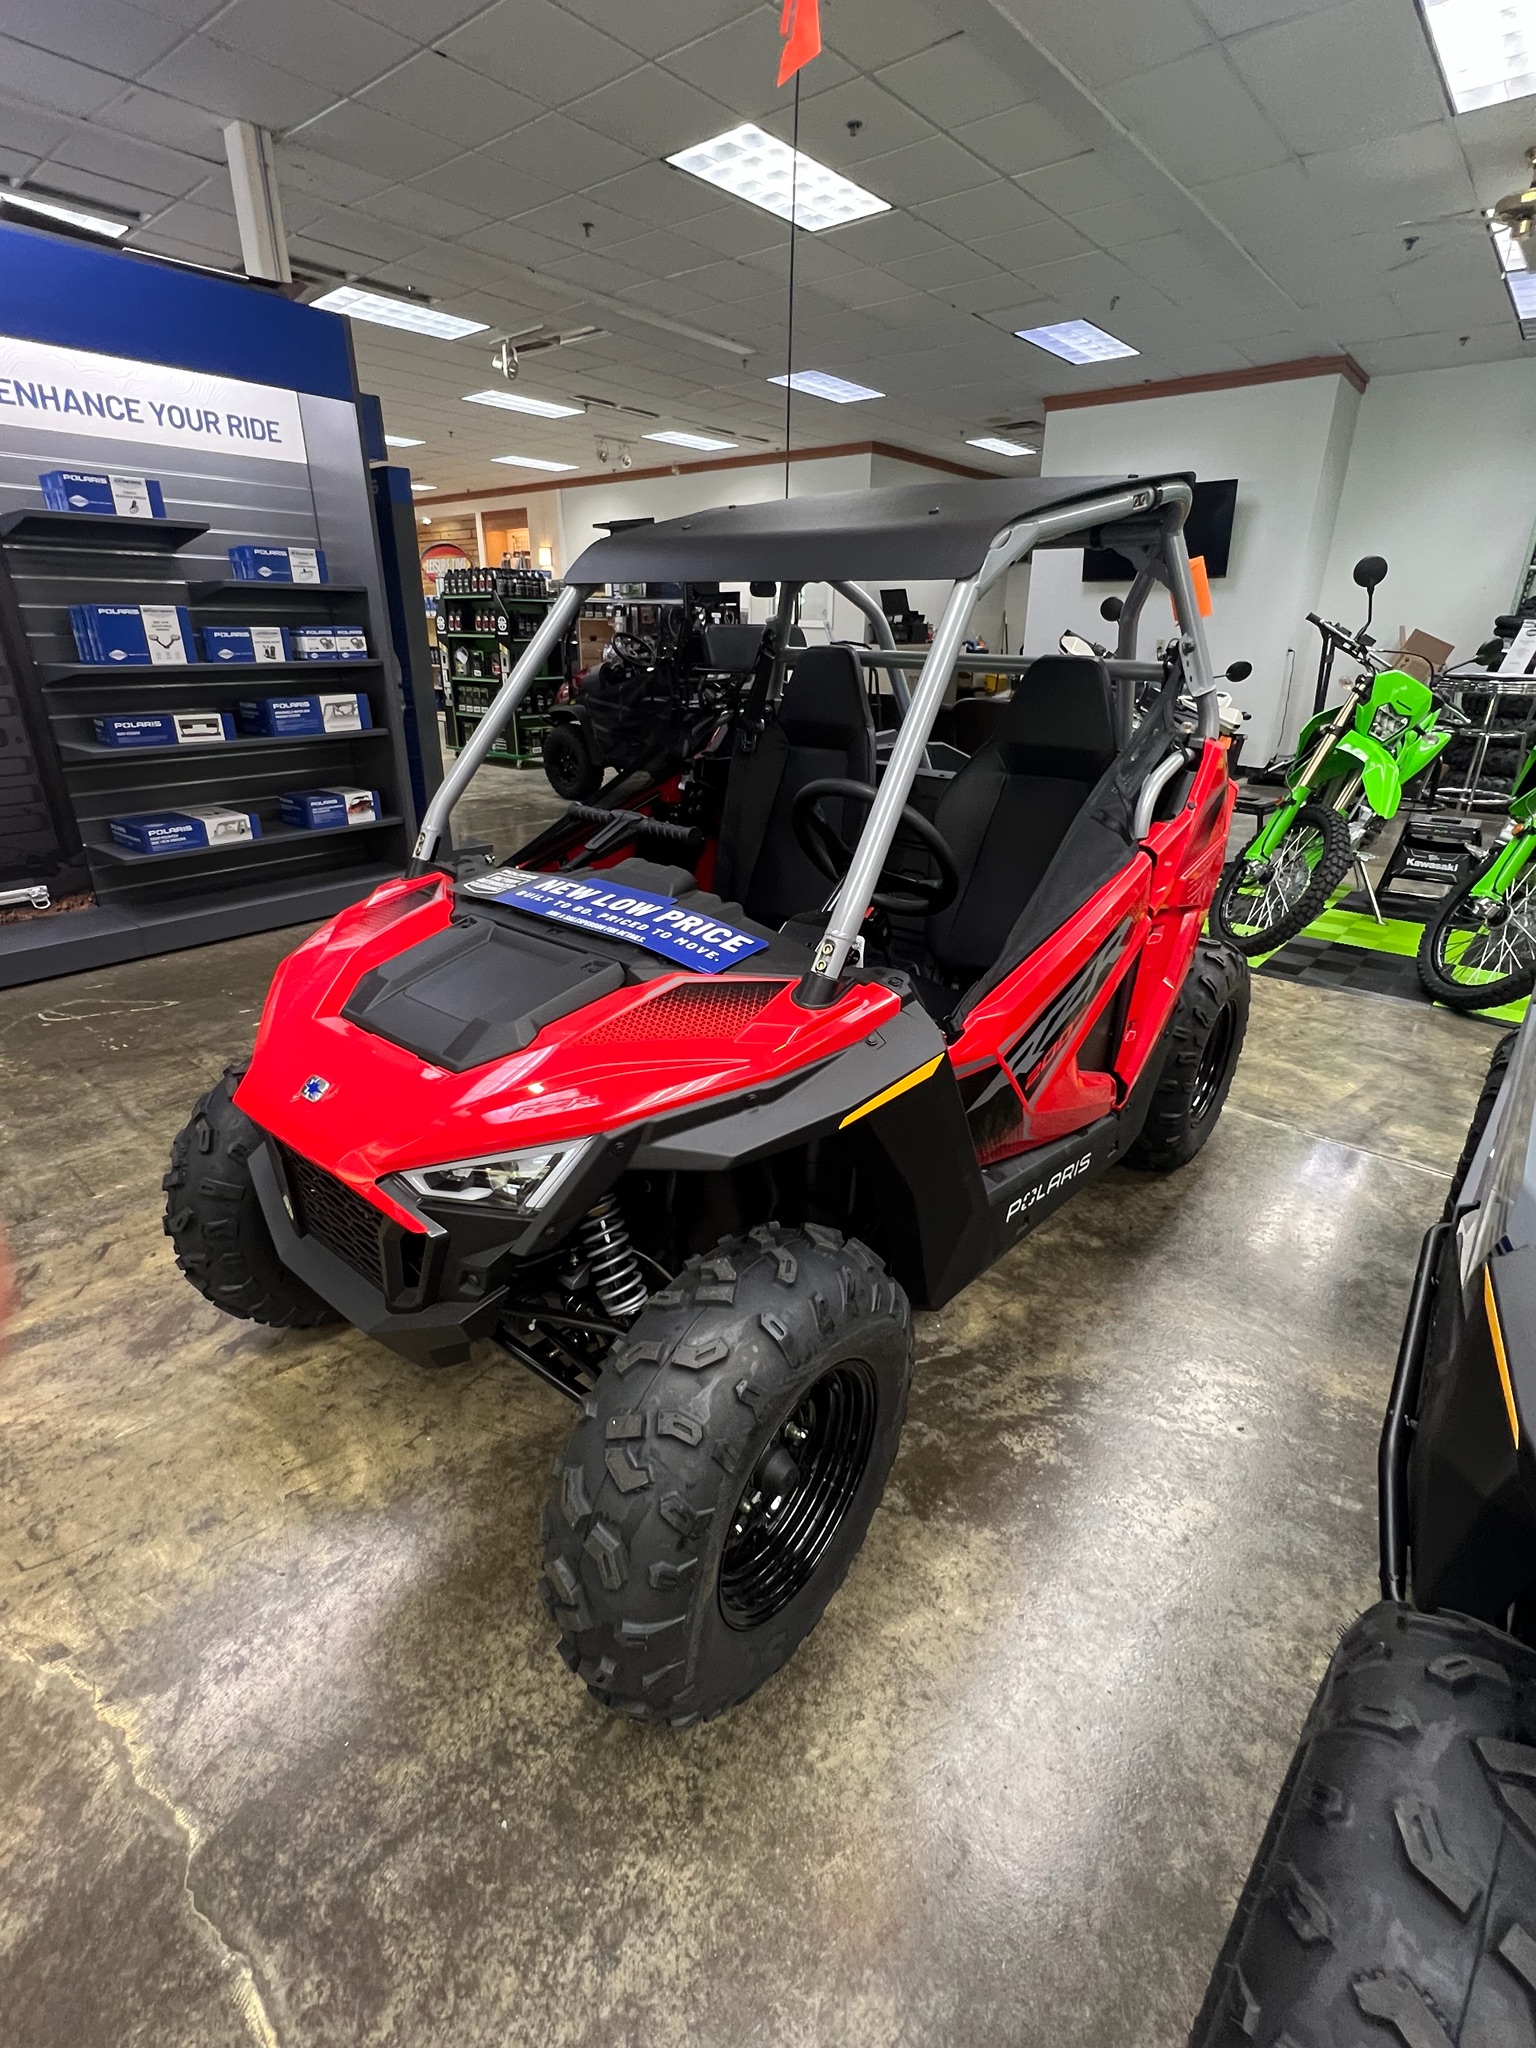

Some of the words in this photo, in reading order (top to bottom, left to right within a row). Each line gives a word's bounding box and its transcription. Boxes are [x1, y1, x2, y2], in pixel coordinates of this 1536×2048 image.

[0, 378, 144, 423] ENHANCE
[148, 401, 222, 435] YOUR
[226, 413, 282, 443] RIDE
[62, 473, 108, 484] POLARIS
[253, 548, 287, 557] POLARIS
[272, 701, 311, 710] POLARIS
[114, 720, 162, 729] POLARIS
[310, 799, 338, 807] POLARIS
[148, 825, 193, 837] POLARIS
[1406, 857, 1459, 872] Kawasaki
[533, 878, 602, 901] NEW
[590, 893, 664, 917] LOW
[652, 909, 755, 954] PRICE
[515, 890, 554, 903] BUILT
[553, 900, 573, 909] TO
[572, 905, 593, 916] GO.
[596, 912, 650, 931] PRICED
[651, 927, 673, 939] TO
[673, 936, 721, 962] MOVE.
[985, 916, 1131, 1095] RZR
[1006, 1151, 1092, 1223] POLARIS
